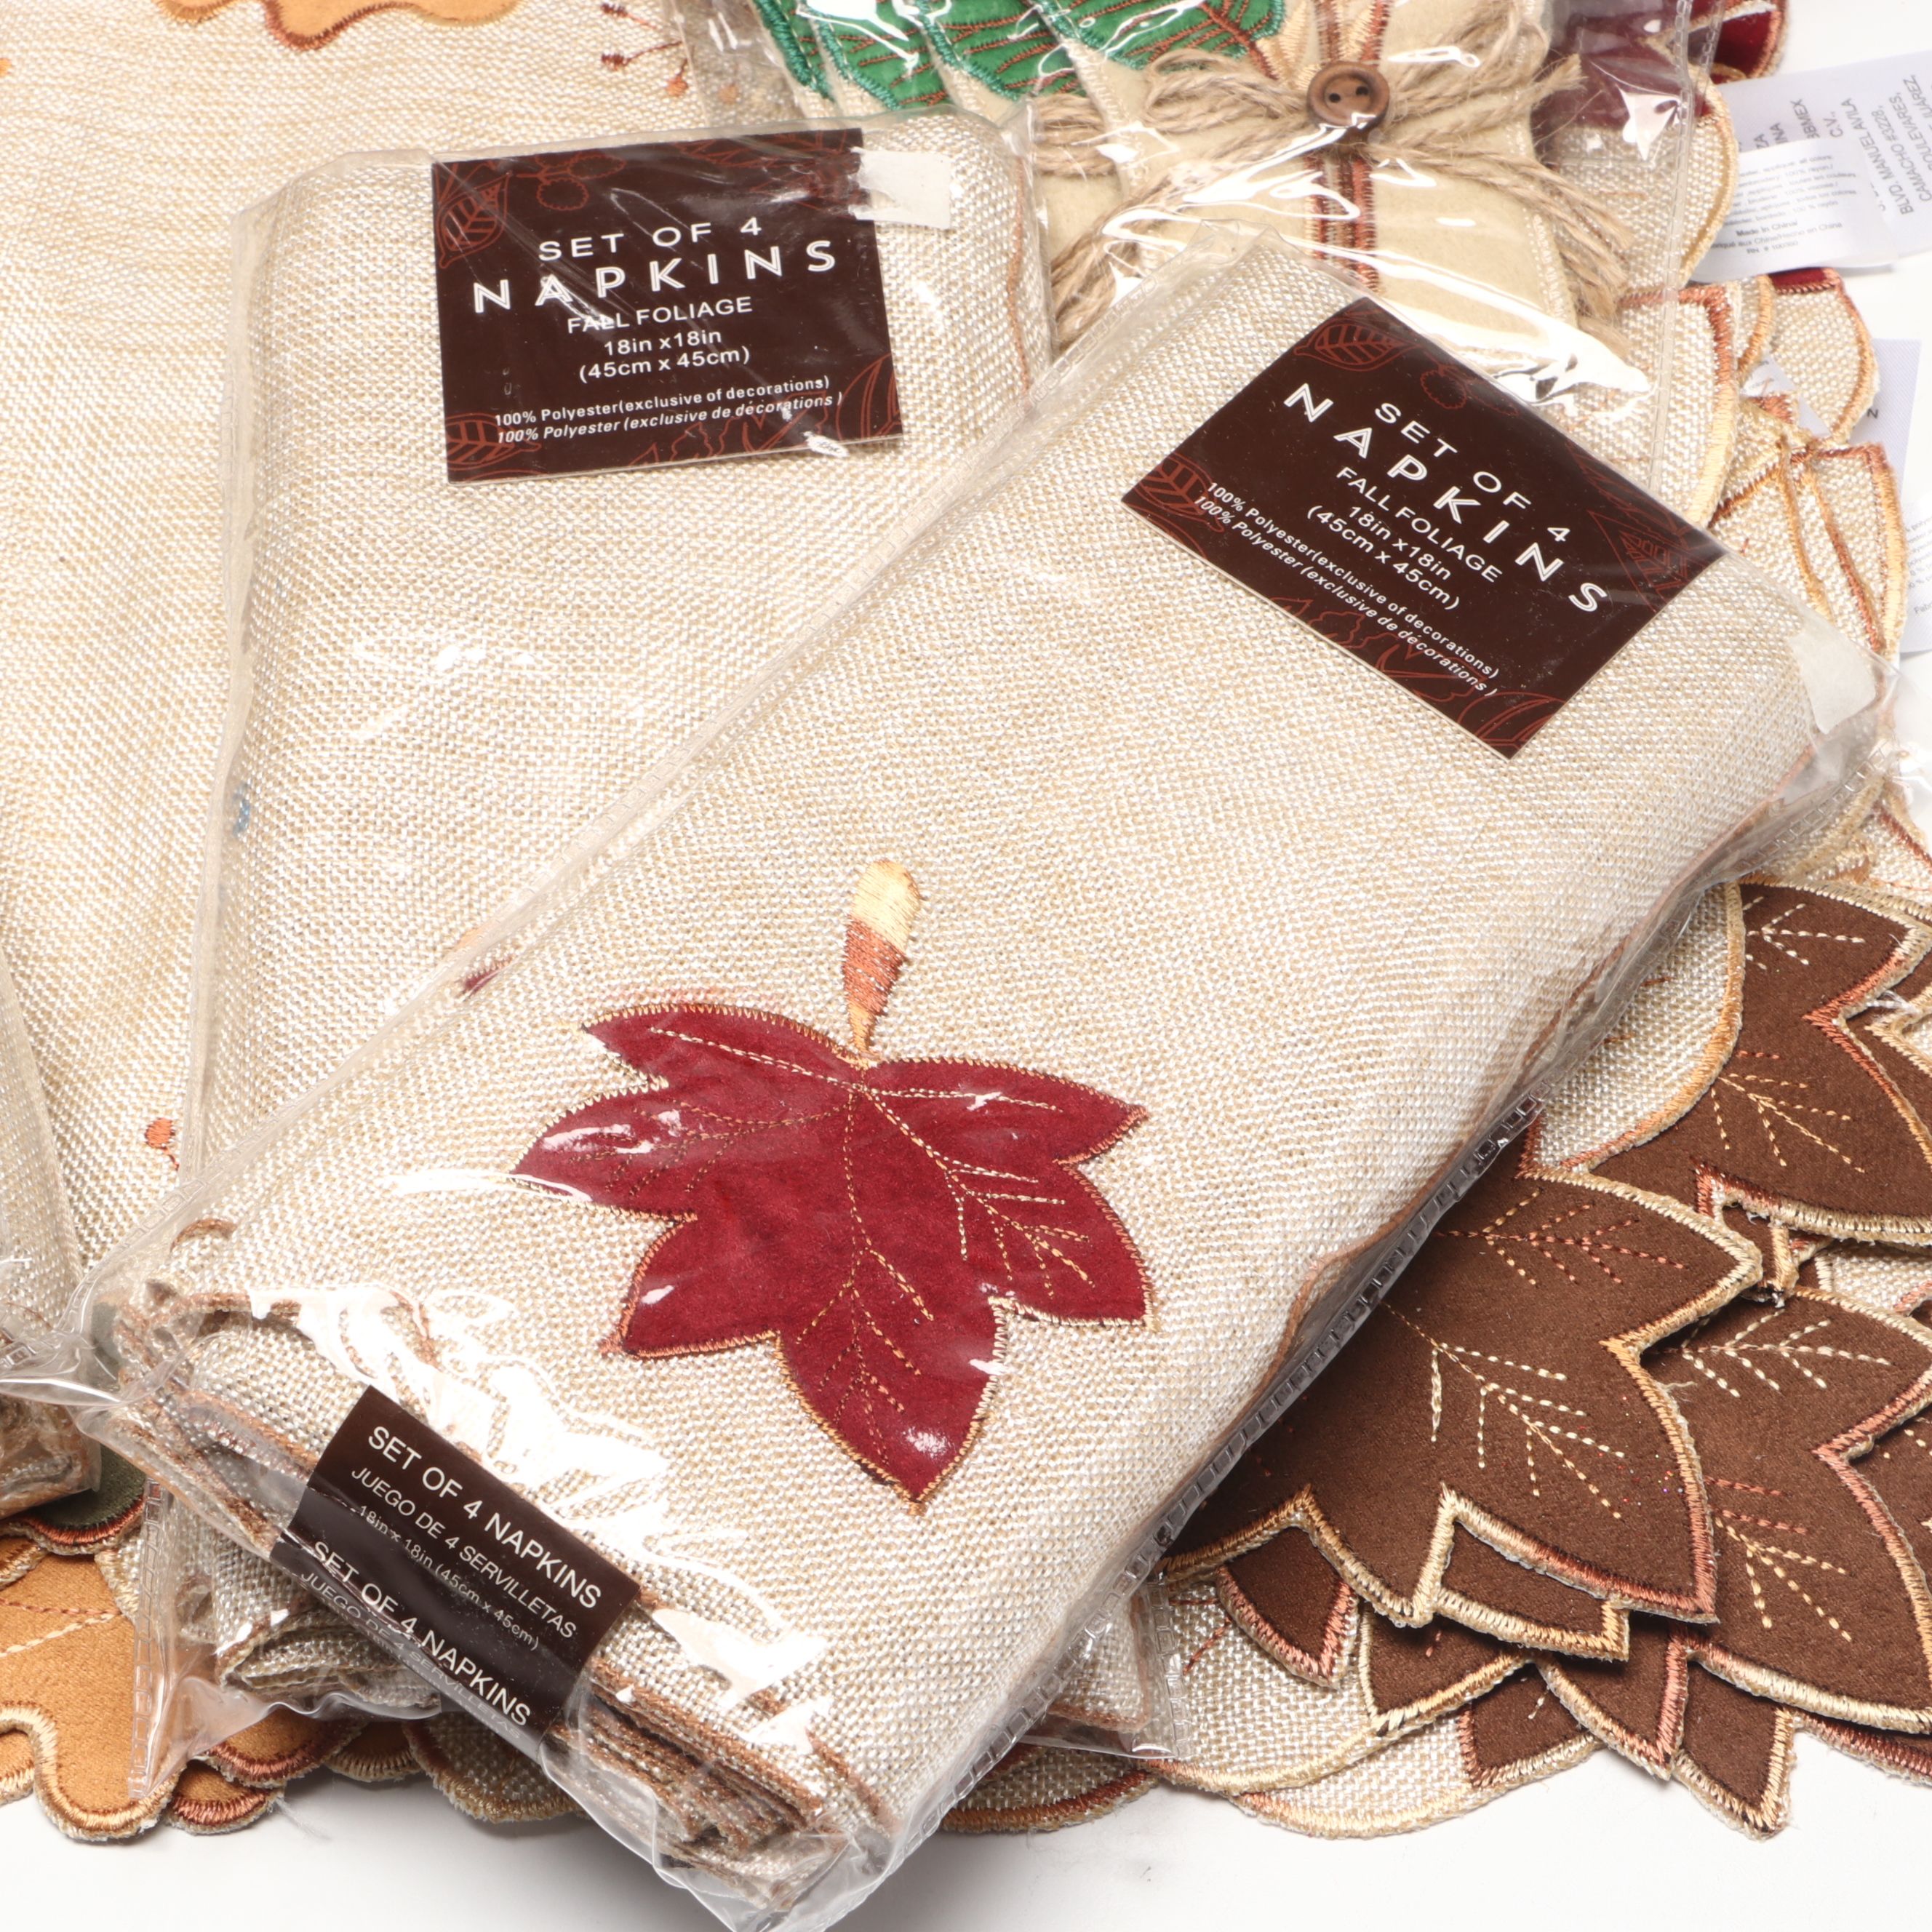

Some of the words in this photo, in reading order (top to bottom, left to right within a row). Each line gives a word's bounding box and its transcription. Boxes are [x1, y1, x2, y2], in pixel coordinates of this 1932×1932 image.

[1841, 97, 1867, 130] AVILA
[1859, 132, 1894, 180] MANUEL
[1891, 143, 1932, 201] CAMACHO
[1888, 180, 1914, 215] BLVD.
[538, 233, 624, 262] SET
[652, 222, 711, 249] OF
[740, 217, 762, 236] 4
[473, 240, 836, 314] NAPKINS
[567, 312, 630, 335] FALL
[636, 296, 753, 325] FOLIAGE
[604, 339, 652, 356] 18in
[579, 361, 652, 384] (45cm
[658, 359, 671, 371] x
[676, 346, 750, 368] 45cm)
[495, 410, 537, 426] 100%
[706, 388, 722, 402] of
[726, 375, 829, 399] decorations)
[498, 427, 539, 444] 100%
[543, 421, 620, 439] Polyester
[623, 411, 708, 431] (exclusive
[711, 406, 731, 419] de
[1283, 383, 1608, 612] NAPKINS
[1375, 403, 1458, 458] SET
[1473, 471, 1531, 509] OF
[1546, 527, 1570, 542] 4
[1336, 466, 1390, 511] FALL
[1395, 506, 1503, 583] FOLIAGE
[1349, 506, 1391, 540] 18in
[1194, 496, 1235, 524] 100%
[1232, 521, 1304, 567] Polyester
[1300, 566, 1378, 618] (exclusive
[1377, 617, 1398, 631] de
[1208, 482, 1246, 512] 100%
[1388, 602, 1408, 615] of
[1405, 614, 1499, 679] decorations)
[1307, 506, 1374, 553] (45cm
[1375, 551, 1391, 564] x
[1392, 562, 1459, 610] 45cm)
[368, 1426, 422, 1470] SET
[422, 1466, 463, 1498] OF
[463, 1500, 483, 1519] 4
[484, 1512, 602, 1608] NAPKINS
[351, 1468, 415, 1516] JUEGO
[415, 1512, 445, 1538] DE
[445, 1537, 460, 1549] 4
[459, 1546, 576, 1637] SERVILLETAS
[358, 1505, 389, 1535] 18in
[403, 1538, 434, 1568] 18in
[434, 1563, 481, 1604] (45cm
[482, 1602, 492, 1613] x
[493, 1608, 540, 1651] 45cm)
[300, 1572, 362, 1618] JUEGO
[365, 1618, 391, 1637] DE
[313, 1541, 360, 1584] SET
[360, 1582, 399, 1619] OF
[400, 1614, 418, 1635] 4
[420, 1629, 532, 1727] NAPKINS
